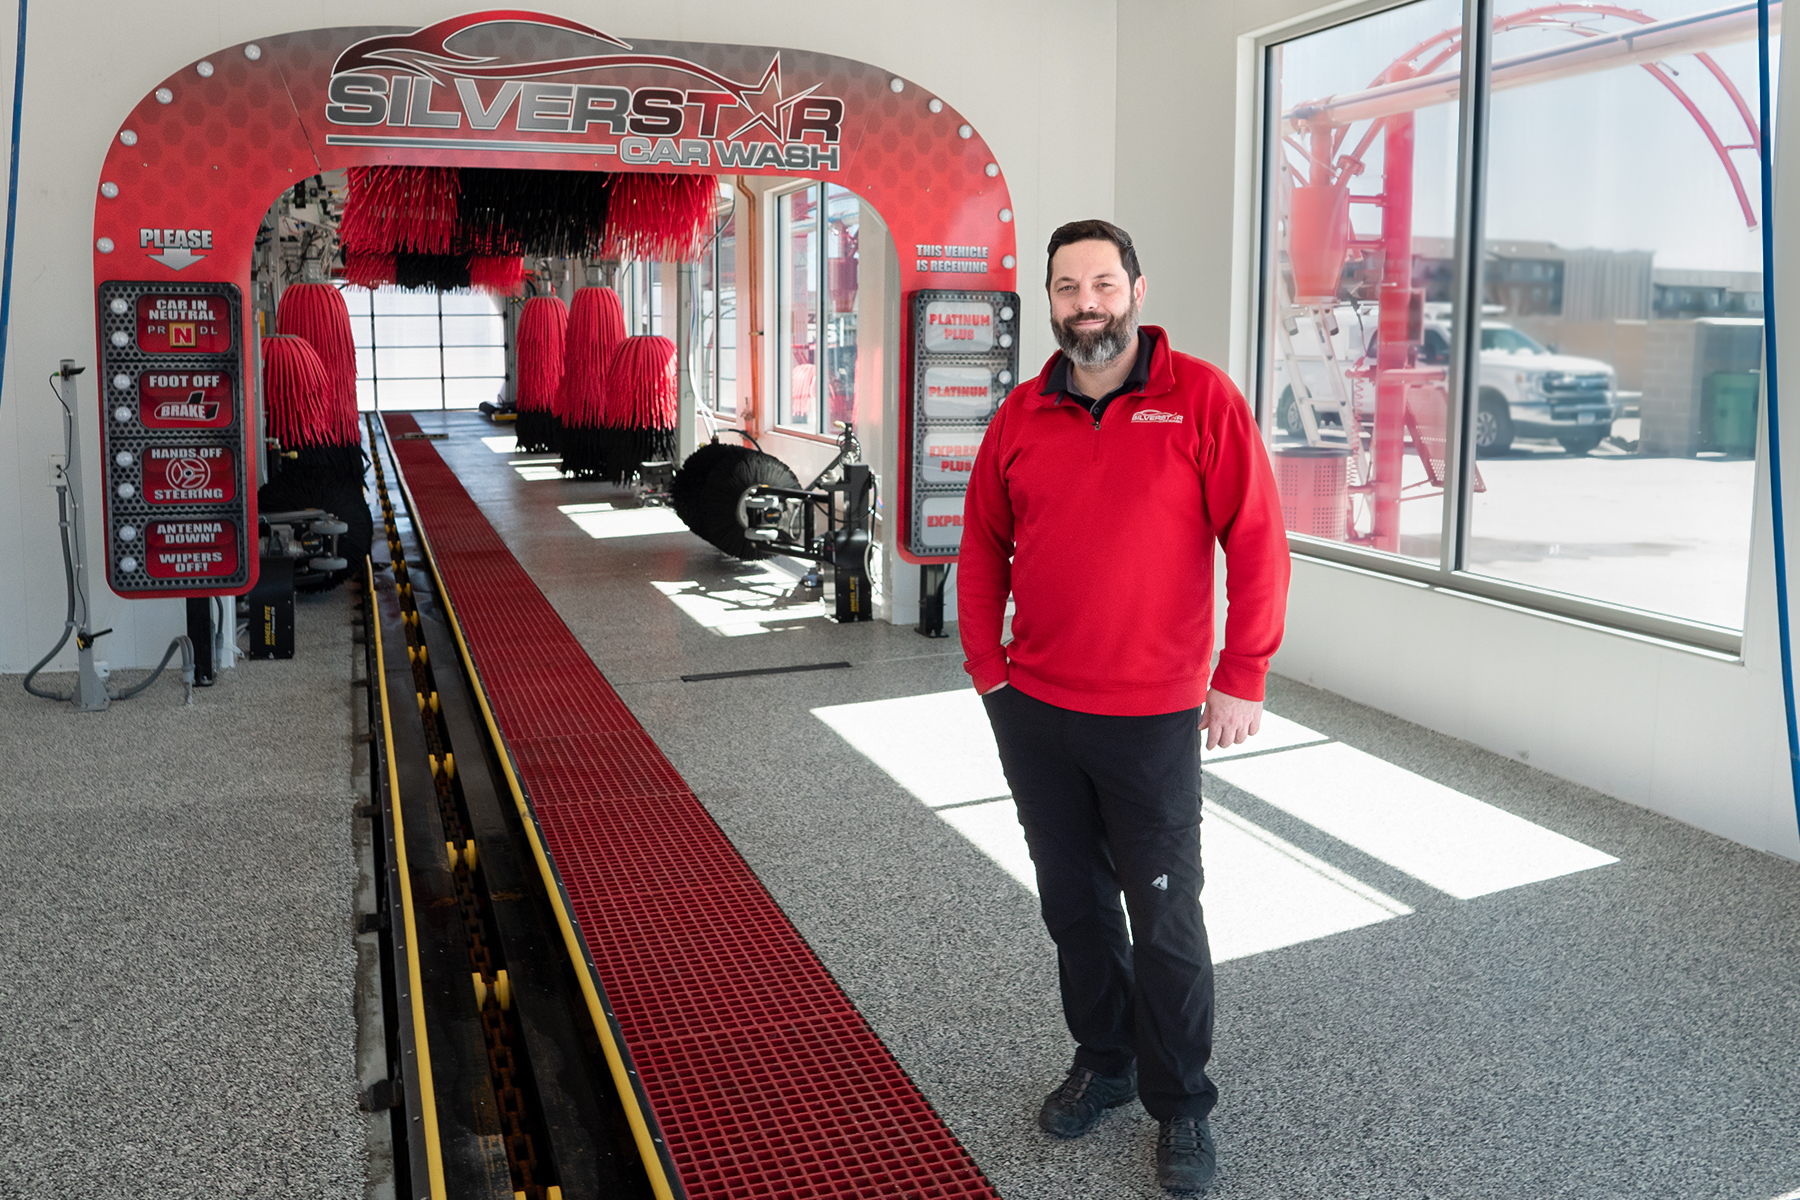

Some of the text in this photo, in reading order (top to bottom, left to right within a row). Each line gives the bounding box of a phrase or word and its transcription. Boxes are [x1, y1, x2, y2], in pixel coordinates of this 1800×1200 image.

[326, 72, 845, 143] SILVERSTAR
[620, 137, 840, 171] CAR WASH
[140, 228, 213, 249] PLEASE
[916, 245, 988, 259] THIS VEHICLE
[916, 260, 988, 273] IS RECEIVING
[156, 299, 208, 311] CAR IN
[148, 309, 216, 321] NEUTRAL
[929, 313, 990, 326] PLATINUM
[944, 328, 974, 340] PLUS
[149, 375, 219, 388] FOOT OFF
[928, 386, 988, 397] PLATINUM
[160, 405, 206, 419] BRAKE
[151, 448, 222, 459] HANDS OFF
[941, 460, 972, 472] PLUS
[154, 488, 223, 500] STEERING
[927, 515, 965, 527] EXPR
[157, 523, 222, 534] ANTENNA
[164, 533, 215, 544] DOWN!
[159, 552, 223, 564] WIPERS
[175, 562, 208, 573] OFF!
